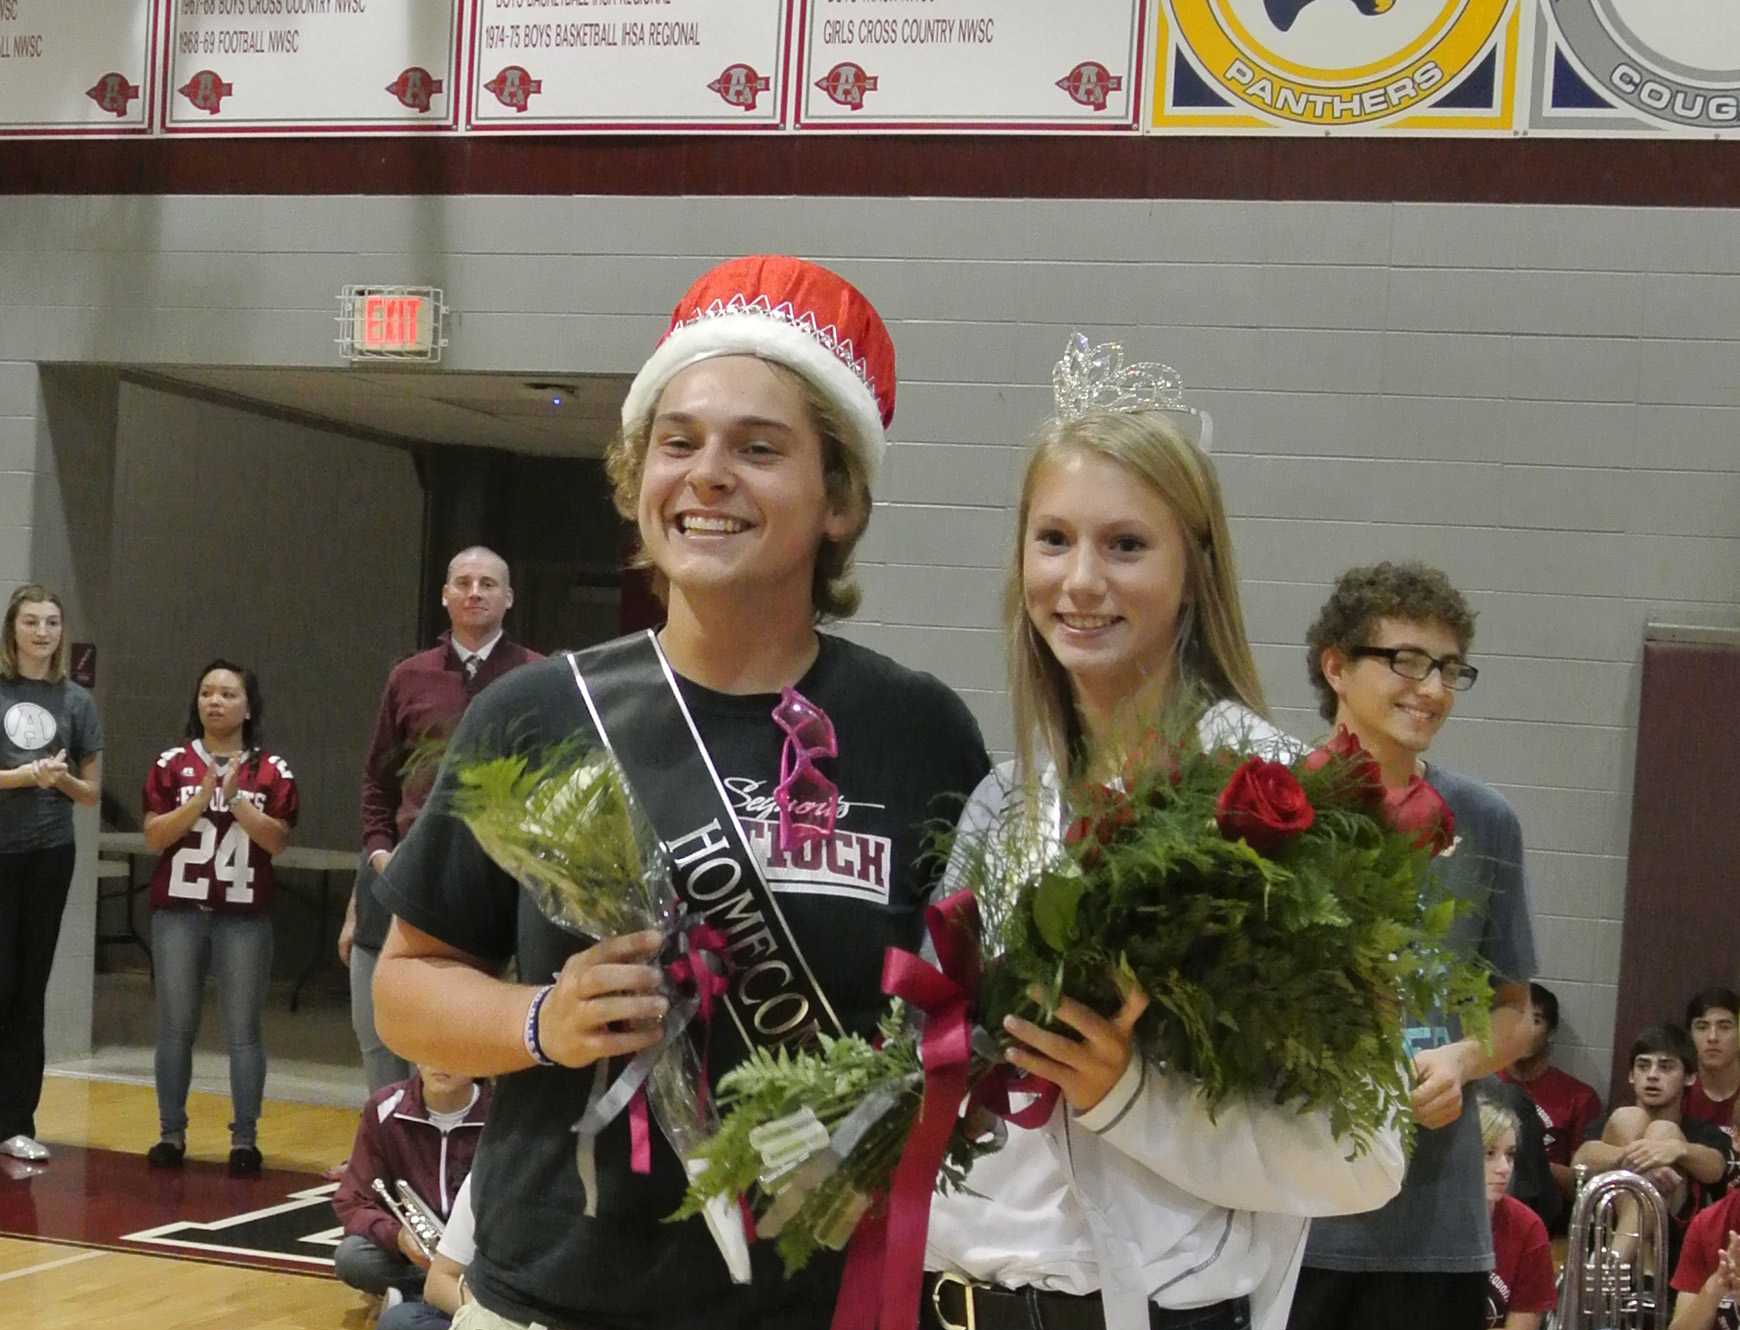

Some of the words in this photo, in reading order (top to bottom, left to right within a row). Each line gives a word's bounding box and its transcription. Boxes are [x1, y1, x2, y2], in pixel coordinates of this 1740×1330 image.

[13, 34, 42, 58] NWSC
[218, 30, 265, 54] FOOTBALL
[268, 29, 300, 53] NWSC
[486, 24, 521, 49] 1974-75
[523, 23, 552, 48] BOYS
[555, 22, 617, 48] BASKETBALL
[621, 21, 645, 47] IHSA
[648, 21, 700, 47] REGIONAL
[823, 19, 855, 45] GIRLS
[858, 18, 898, 44] CROSS
[901, 18, 954, 44] COUNTRY
[958, 18, 995, 43] NWSC
[1224, 57, 1444, 119] PANTHERS
[366, 299, 422, 344] EXIT
[168, 817, 255, 903] 24
[665, 817, 821, 1047] HOMECO
